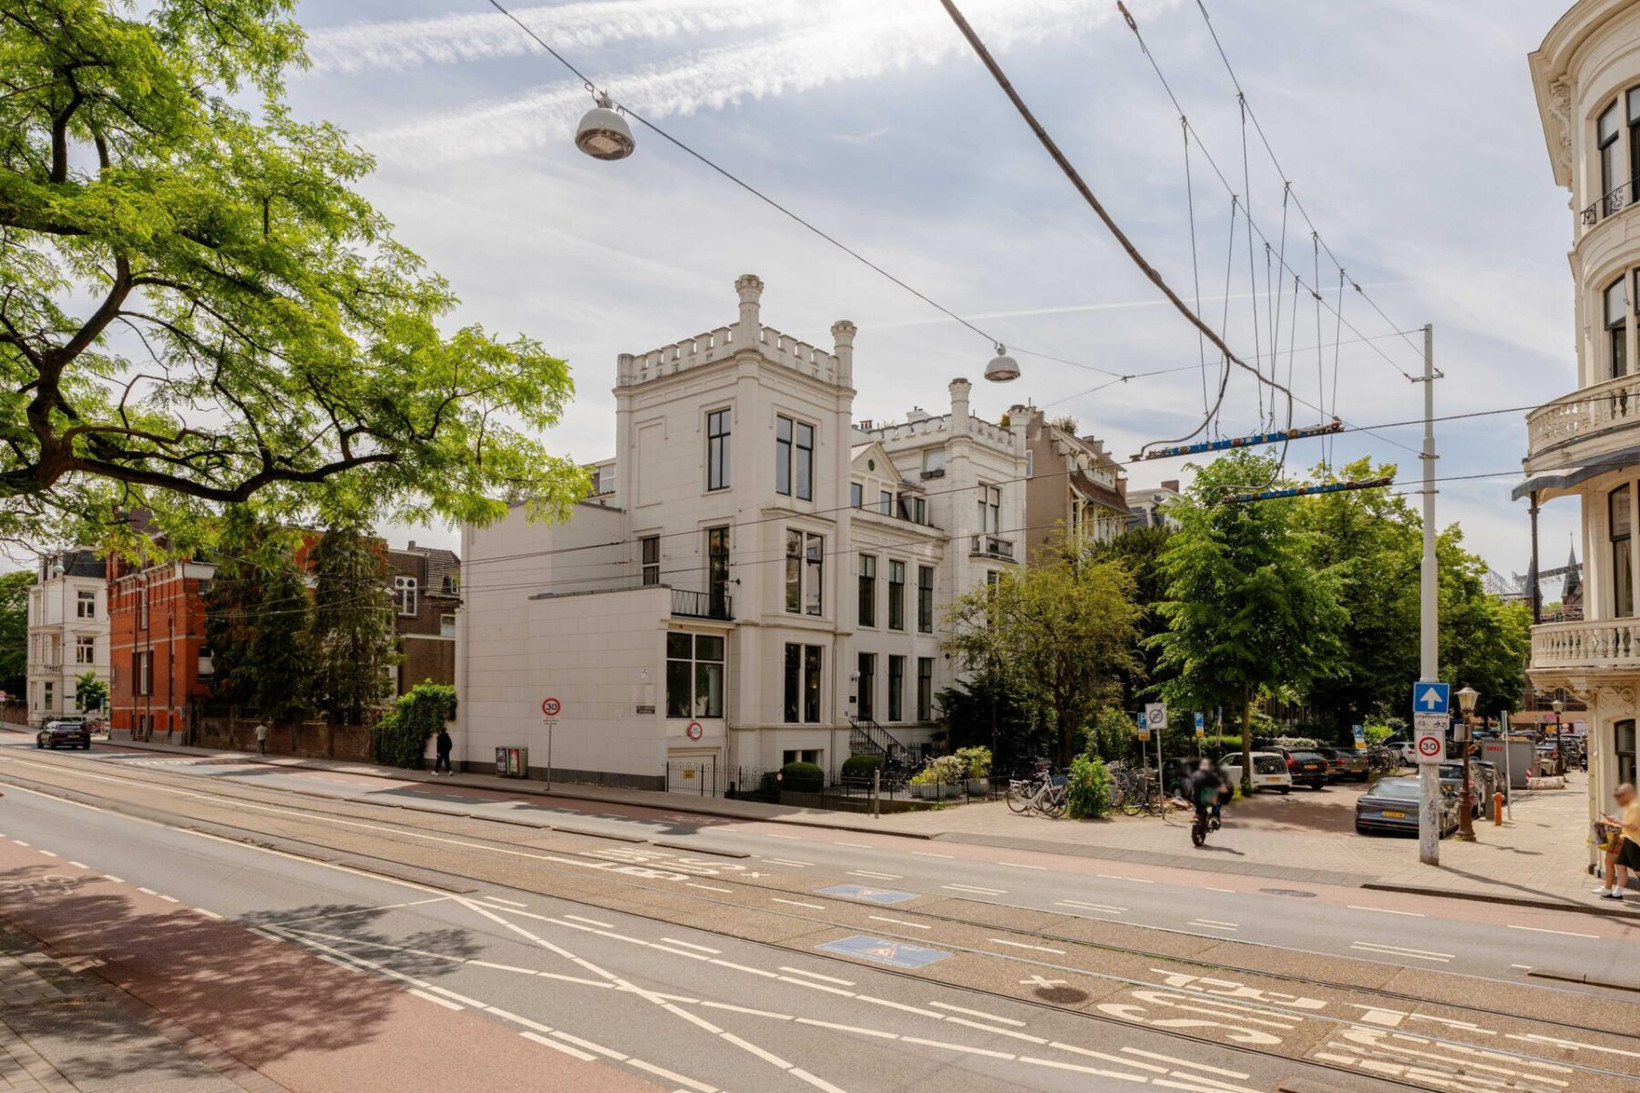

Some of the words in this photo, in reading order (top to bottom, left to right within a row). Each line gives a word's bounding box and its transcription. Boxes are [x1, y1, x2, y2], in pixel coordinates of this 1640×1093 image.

[545, 703, 558, 711] 30
[1423, 743, 1437, 751] 30
[1096, 968, 1328, 1045] BUS
